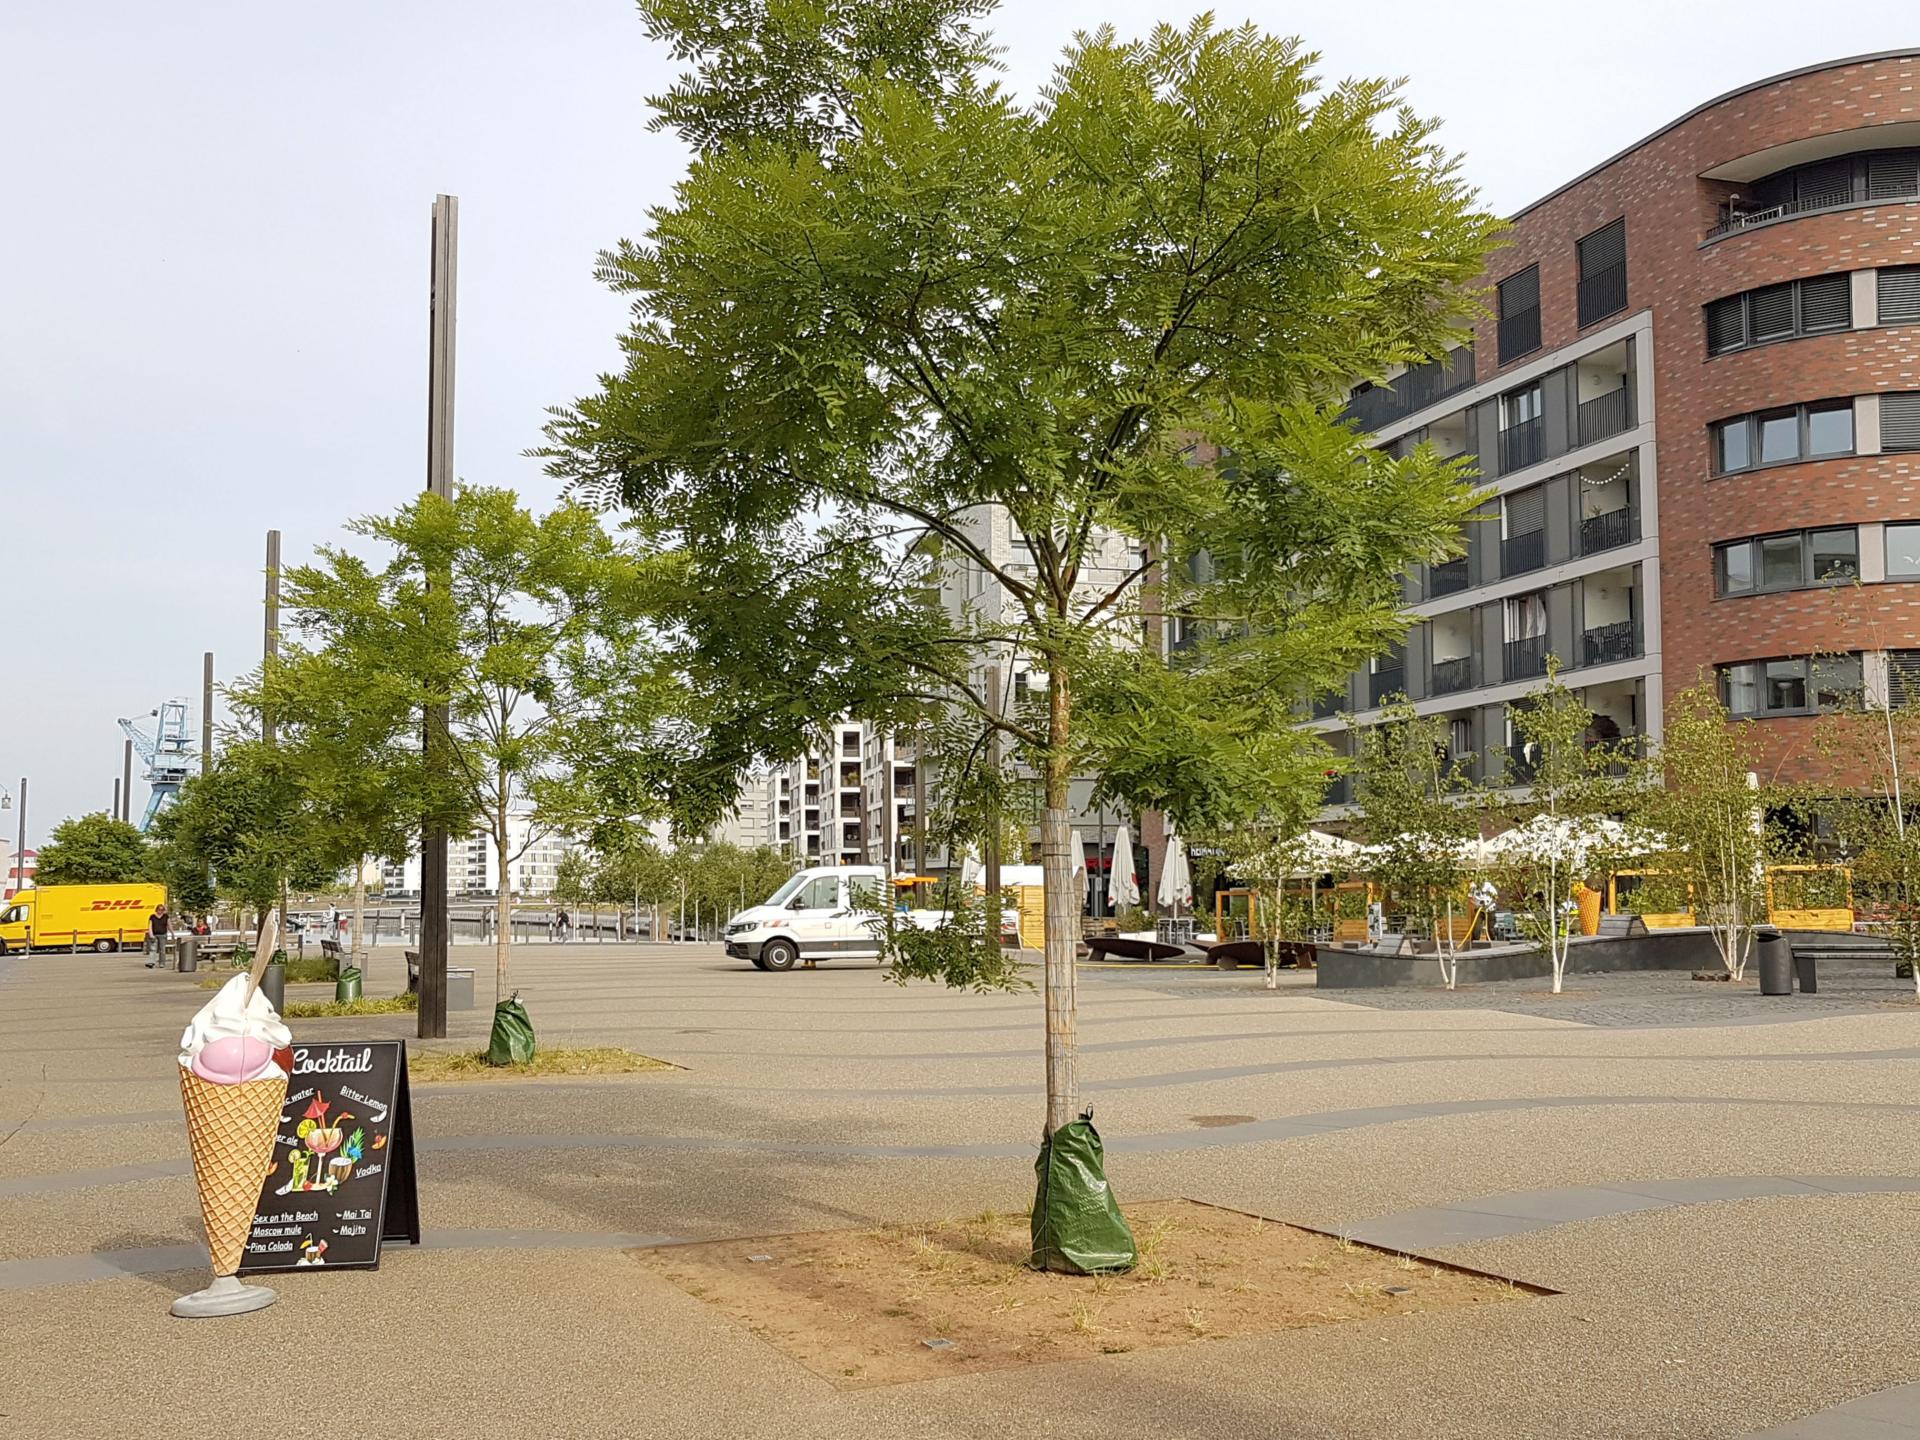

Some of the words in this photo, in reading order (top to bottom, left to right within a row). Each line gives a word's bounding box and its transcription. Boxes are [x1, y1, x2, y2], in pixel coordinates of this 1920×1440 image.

[91, 899, 144, 911] DHL
[292, 1048, 373, 1074] Cocktail
[291, 1087, 314, 1102] water
[340, 1085, 364, 1102] Bitter
[363, 1095, 388, 1111] Lemon
[286, 1137, 299, 1146] ale
[355, 1164, 382, 1179] Vodka
[253, 1214, 268, 1224] Sex
[269, 1215, 279, 1223] on
[281, 1212, 294, 1222] the
[295, 1210, 319, 1221] Beach
[342, 1209, 358, 1220] Mai
[360, 1209, 372, 1219] Tai
[252, 1227, 283, 1237] Moscow
[284, 1224, 302, 1235] mule
[340, 1225, 367, 1236] Mojito
[268, 1241, 294, 1252] Colada
